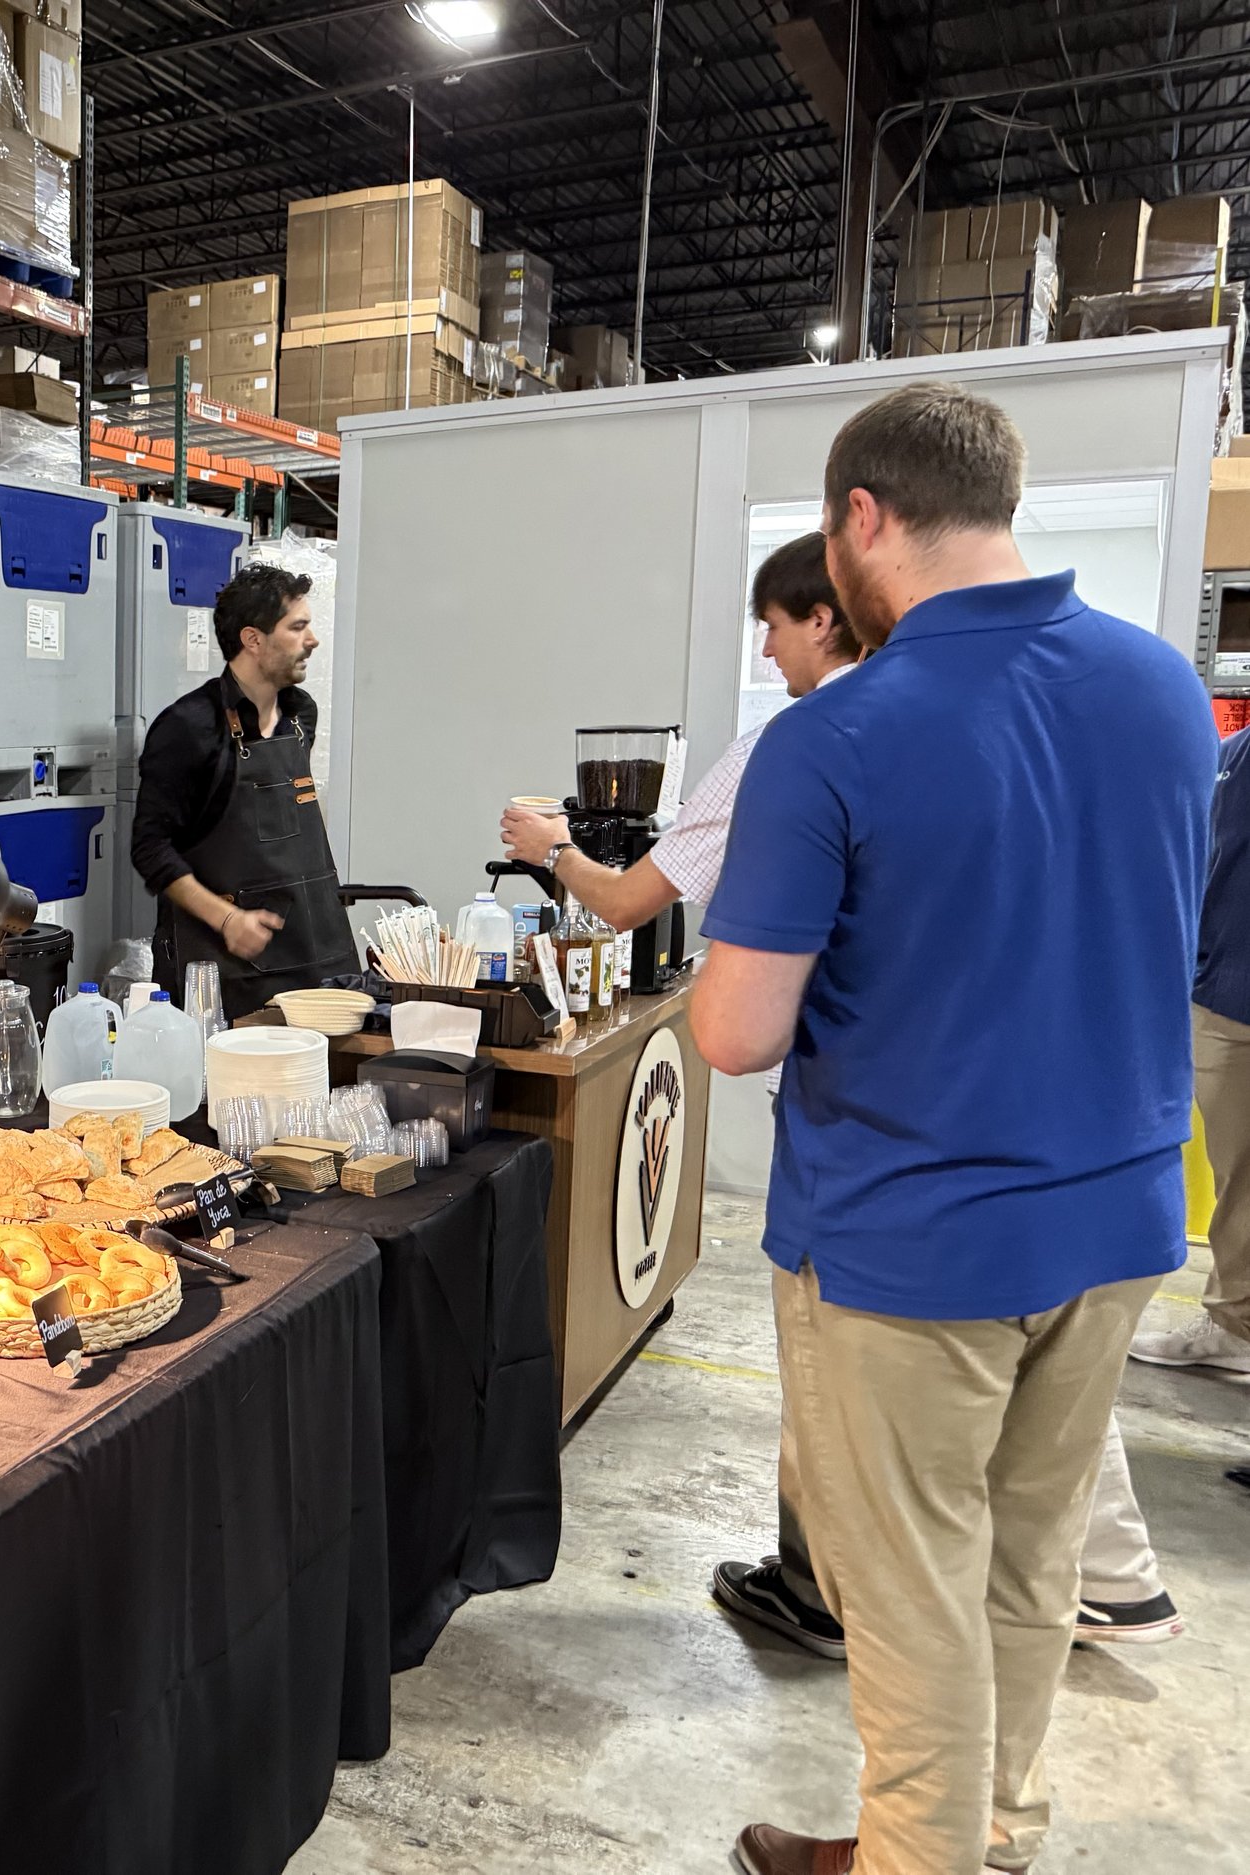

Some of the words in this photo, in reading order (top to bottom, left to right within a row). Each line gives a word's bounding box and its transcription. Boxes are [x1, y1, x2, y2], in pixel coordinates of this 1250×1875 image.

[197, 1188, 216, 1207] Pan
[215, 1180, 227, 1198] de
[207, 1204, 231, 1228] Yuca
